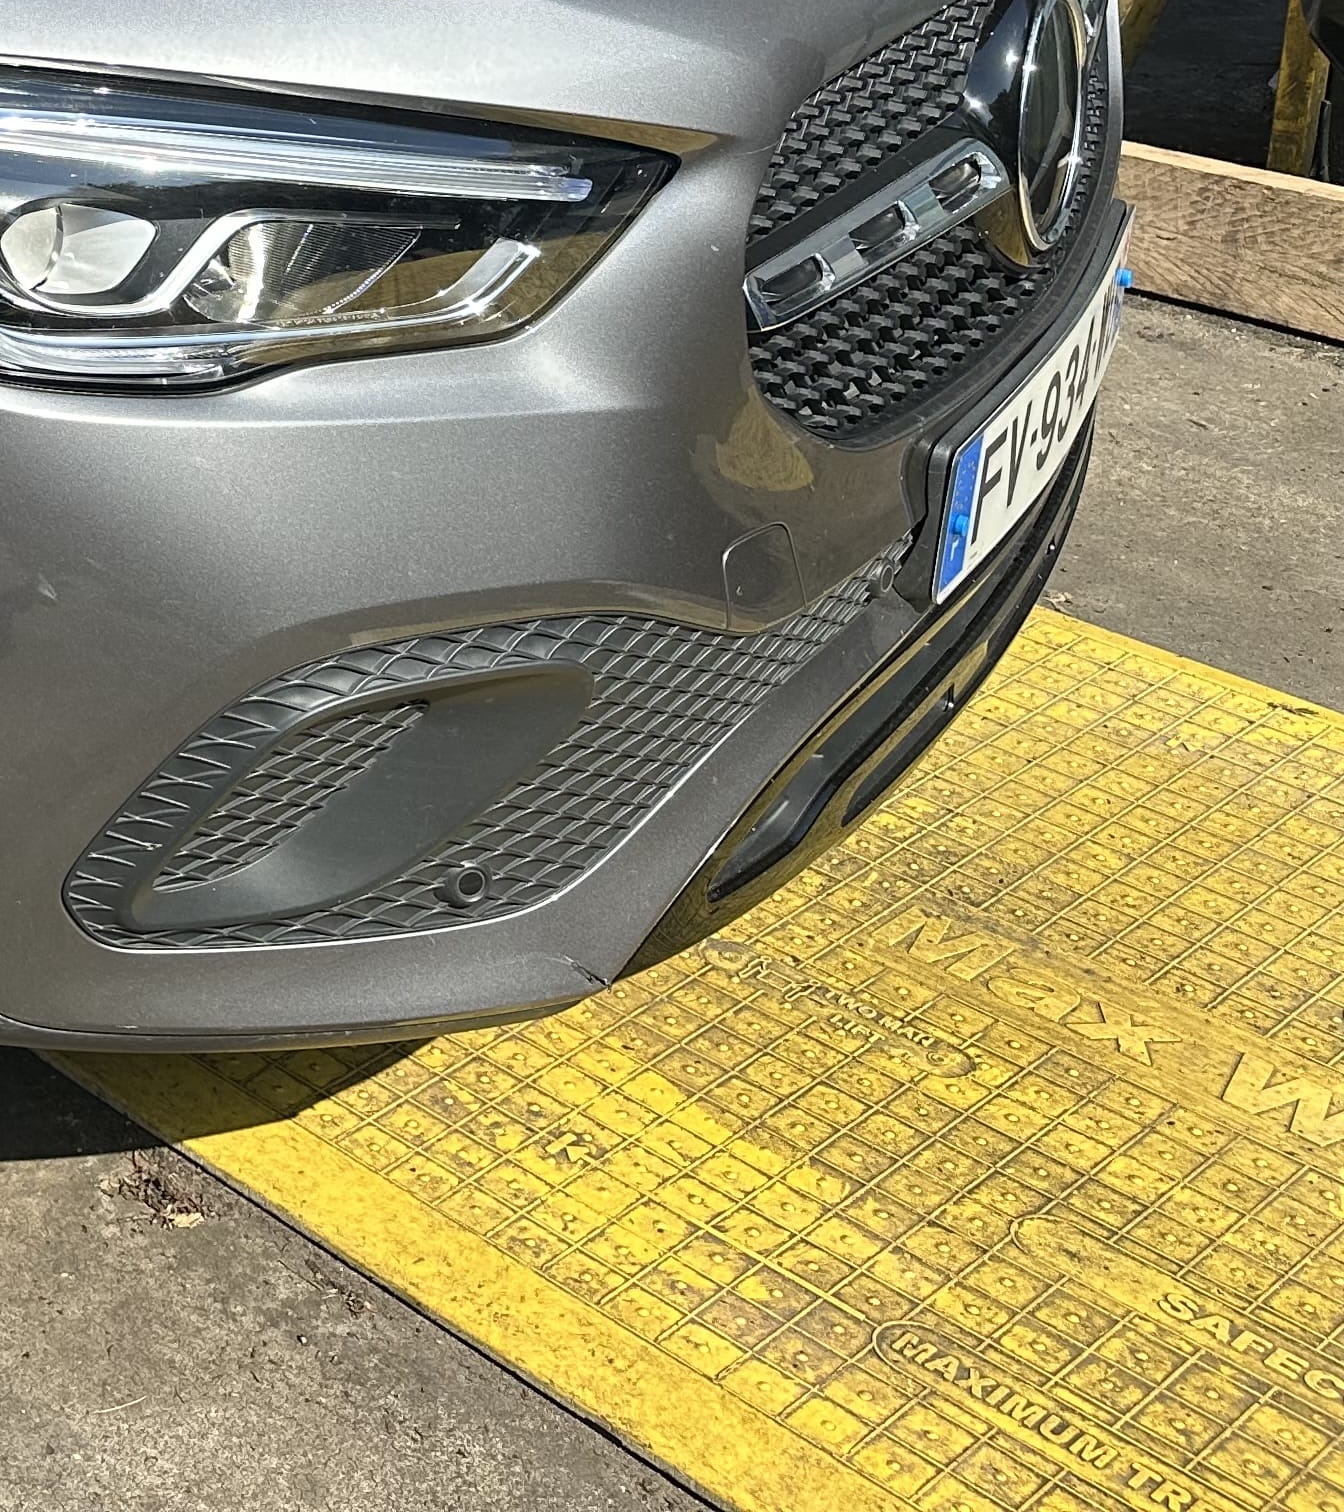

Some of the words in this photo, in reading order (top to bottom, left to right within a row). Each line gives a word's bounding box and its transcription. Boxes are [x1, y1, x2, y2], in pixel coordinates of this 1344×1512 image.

[970, 285, 1116, 546] FV-934-
[823, 988, 879, 1022] TWO
[877, 1013, 937, 1047] MAN
[827, 1012, 887, 1045] LIFT
[869, 905, 1183, 1067] Max
[890, 1330, 1119, 1471] MAXIMUM
